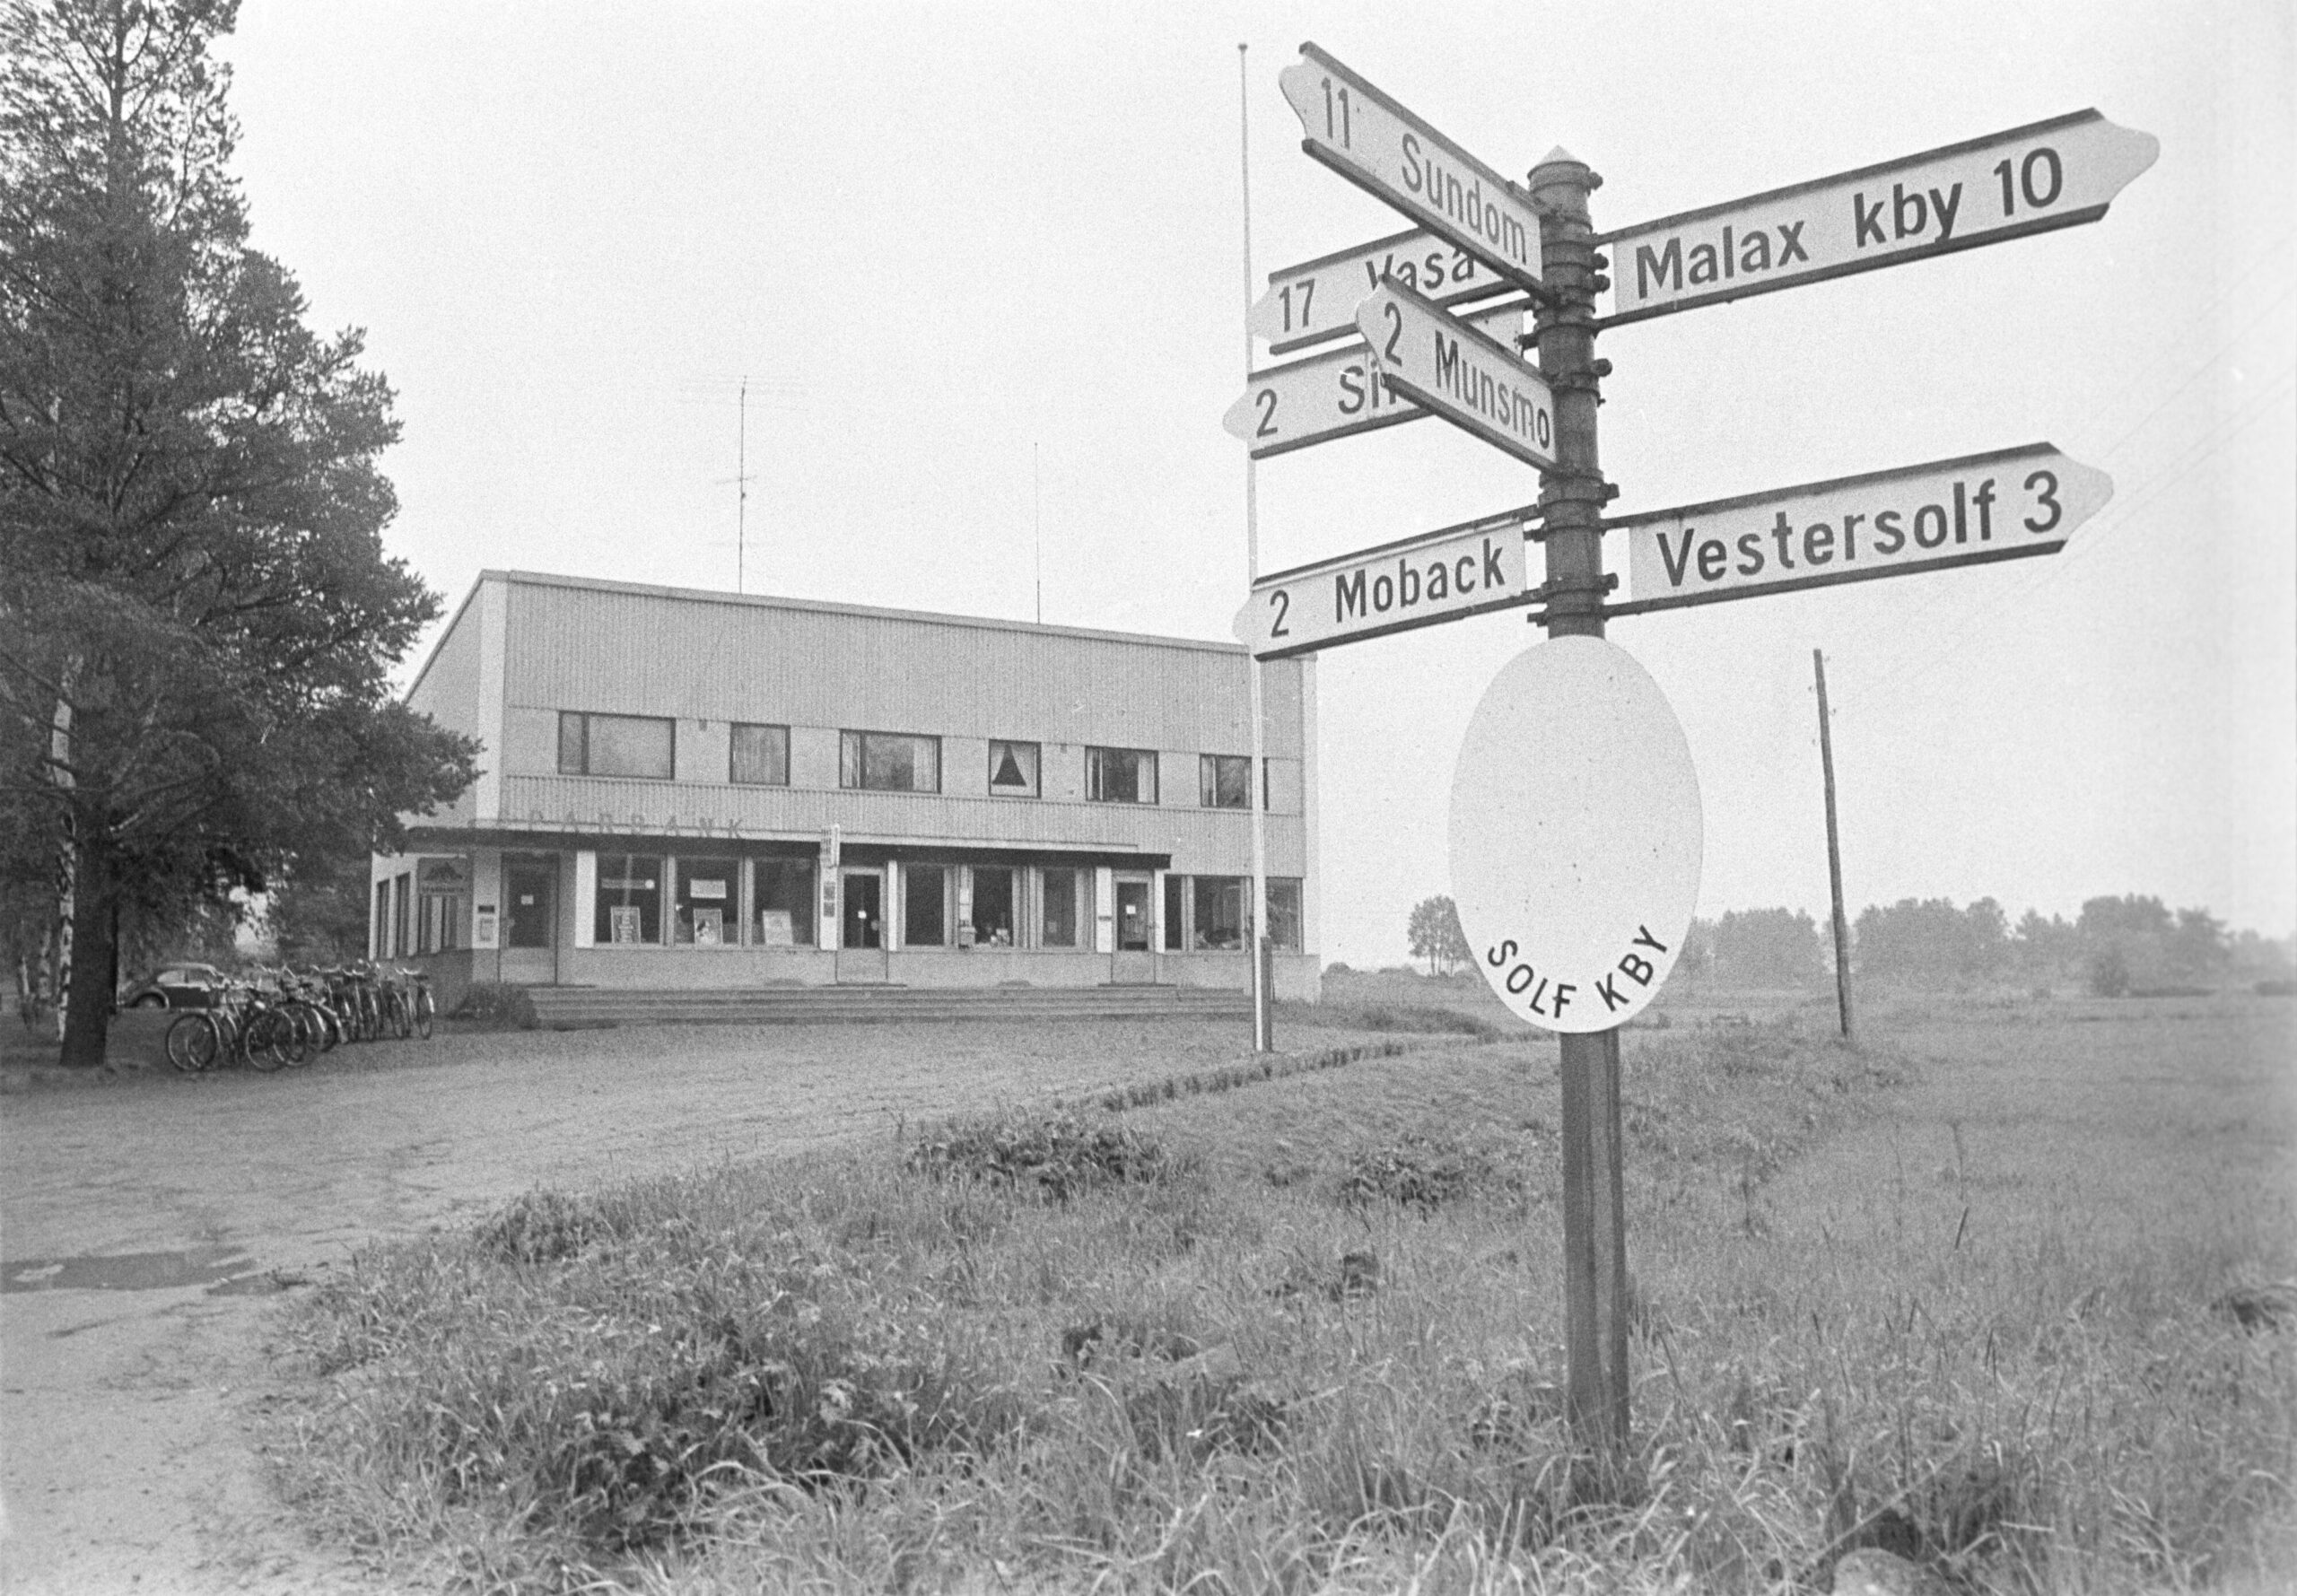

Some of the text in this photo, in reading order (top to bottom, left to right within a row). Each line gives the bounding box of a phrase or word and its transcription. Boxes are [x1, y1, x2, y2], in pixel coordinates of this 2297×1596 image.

[1321, 77, 1528, 266] 11 Sundom
[1635, 147, 2064, 301] Malax kby 10
[1279, 248, 1474, 333] 17 Vasa
[1256, 388, 1278, 438] 2
[1384, 301, 1550, 449] 2 Munsmo
[1656, 470, 2063, 589] Vestersolf 3
[1270, 538, 1506, 638] 2 Moback
[1488, 924, 1667, 1018] SOLF KBY
